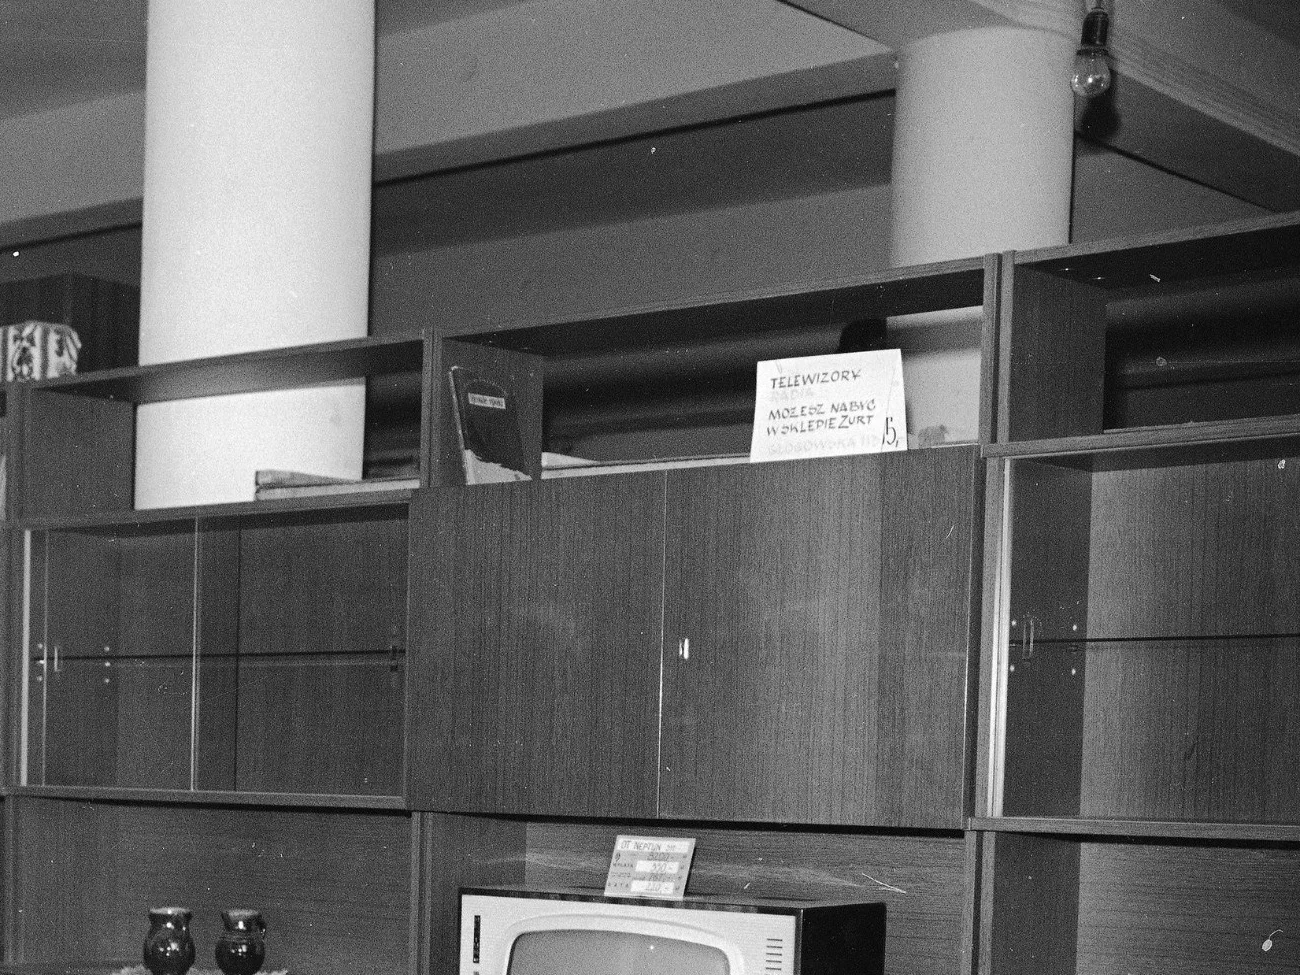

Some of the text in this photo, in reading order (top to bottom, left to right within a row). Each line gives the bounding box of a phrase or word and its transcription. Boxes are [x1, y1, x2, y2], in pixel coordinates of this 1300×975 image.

[770, 369, 861, 389] TELEWIZORY
[766, 414, 875, 436] W SKLEPIE ZURT
